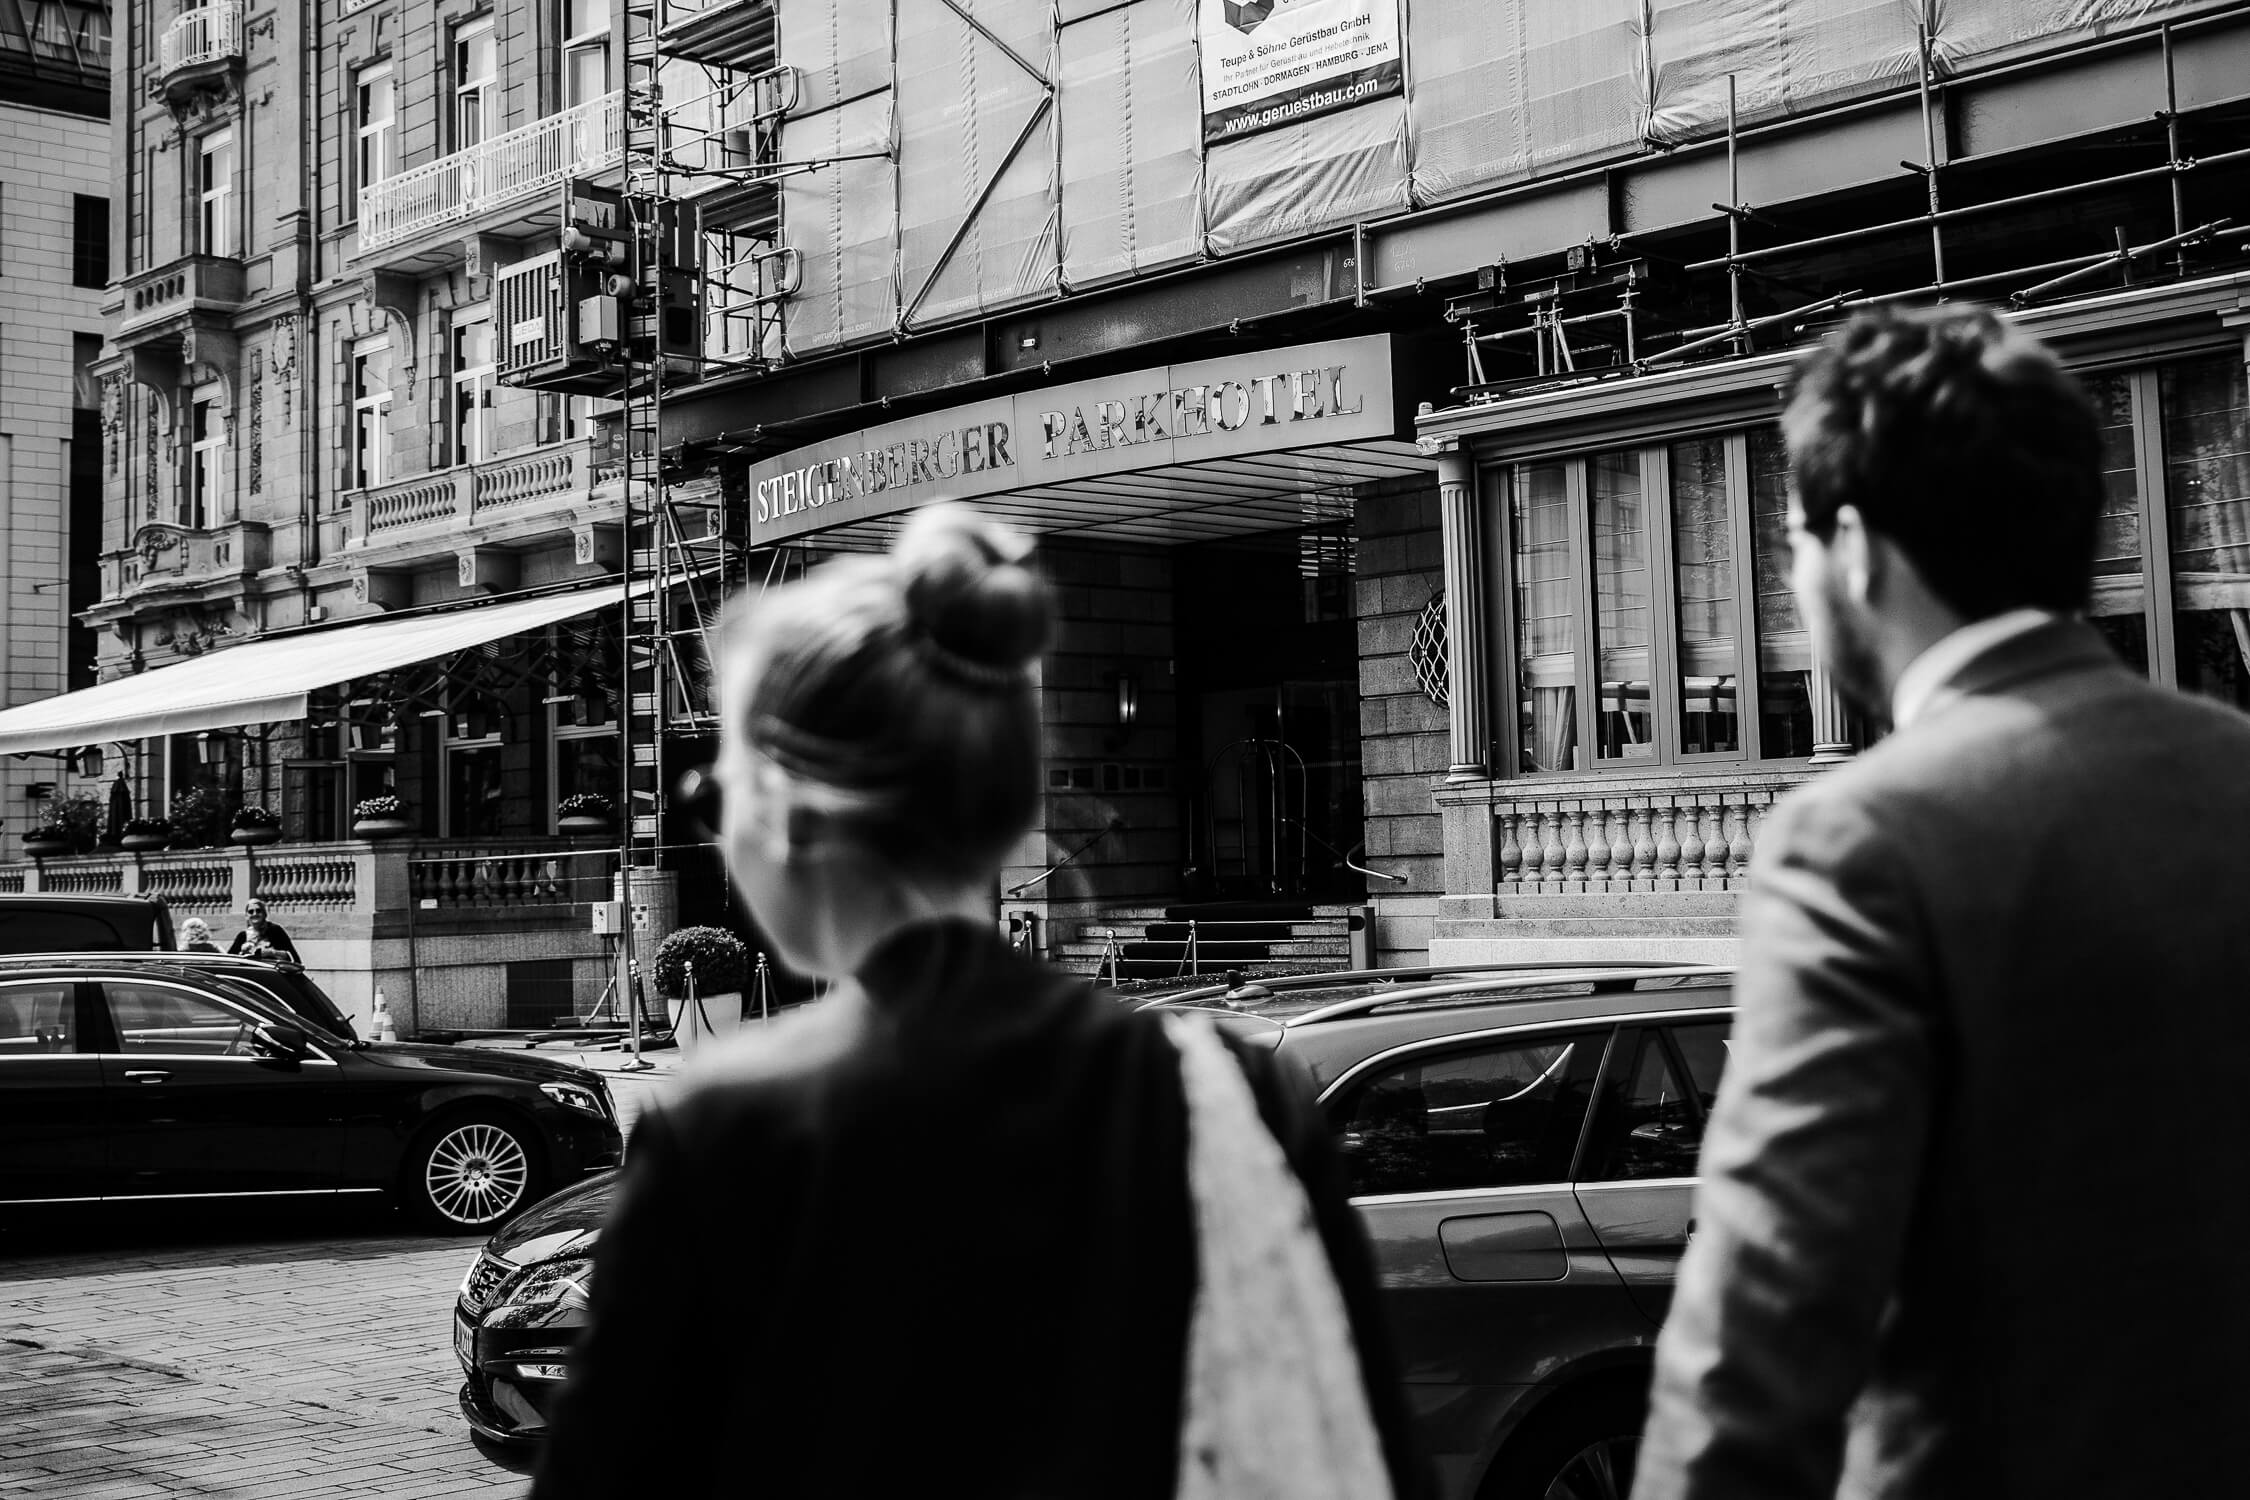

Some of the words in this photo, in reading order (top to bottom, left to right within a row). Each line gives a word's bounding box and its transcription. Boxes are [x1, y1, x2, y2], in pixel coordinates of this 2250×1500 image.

[1220, 54, 1247, 69] Teupe
[1249, 49, 1255, 60] &
[1256, 41, 1287, 57] Söhne
[1289, 25, 1338, 48] Gerüstbau
[1340, 13, 1371, 32] GmbH
[1223, 73, 1233, 83] Ihr
[1235, 66, 1258, 81] Patner
[1325, 31, 1370, 51] Hebetehnik
[1212, 80, 1259, 101] STADTLOHN
[1263, 65, 1310, 87] DORMAGEN
[1315, 49, 1359, 71] HAMBURG
[1365, 41, 1389, 57] JENA
[1225, 77, 1378, 133] www.geruestbau.com
[757, 421, 1015, 525] STEIGENBERGER
[1040, 364, 1363, 460] PARKHOTEL
